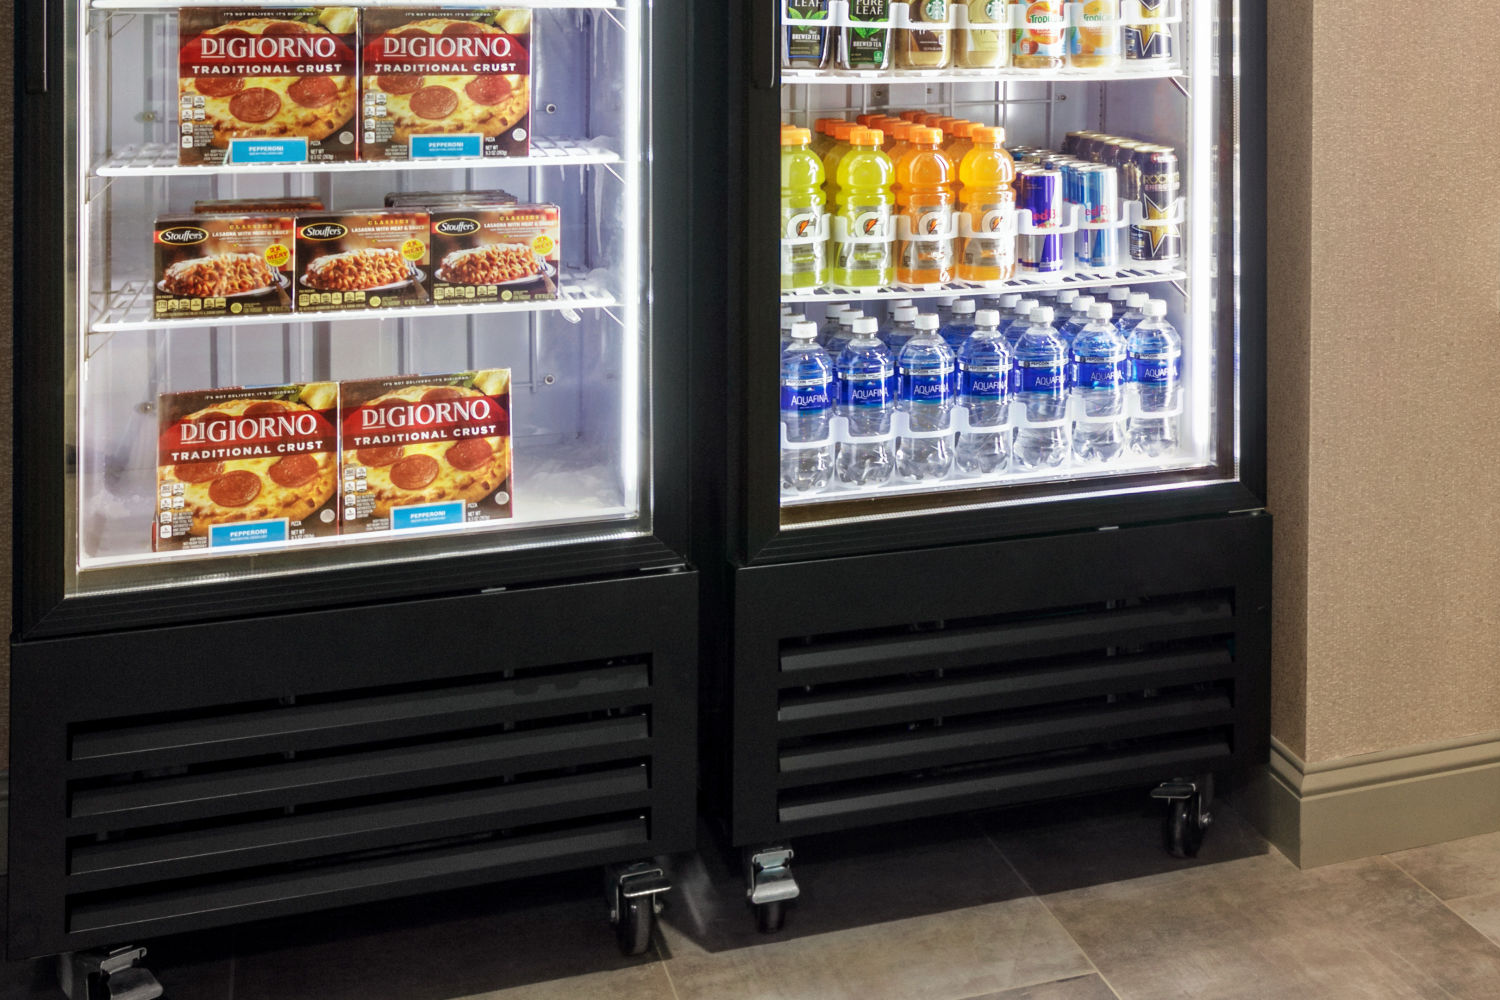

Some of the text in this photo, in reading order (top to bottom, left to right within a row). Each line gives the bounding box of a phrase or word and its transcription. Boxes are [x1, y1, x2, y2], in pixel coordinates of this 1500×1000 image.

[192, 64, 342, 75] TRADITIONAL CRUST
[375, 62, 517, 74] TRADITIONAL CRUST
[306, 225, 343, 238] Stouffer's
[441, 222, 475, 232] Stouffer's
[165, 229, 204, 243] Stouffer's
[791, 393, 829, 408] AQUAFINA
[852, 388, 889, 401] AQUAFINA
[354, 425, 497, 446] TRADITIONAL CRUST
[172, 440, 323, 461] TRADITIONAL CRUST
